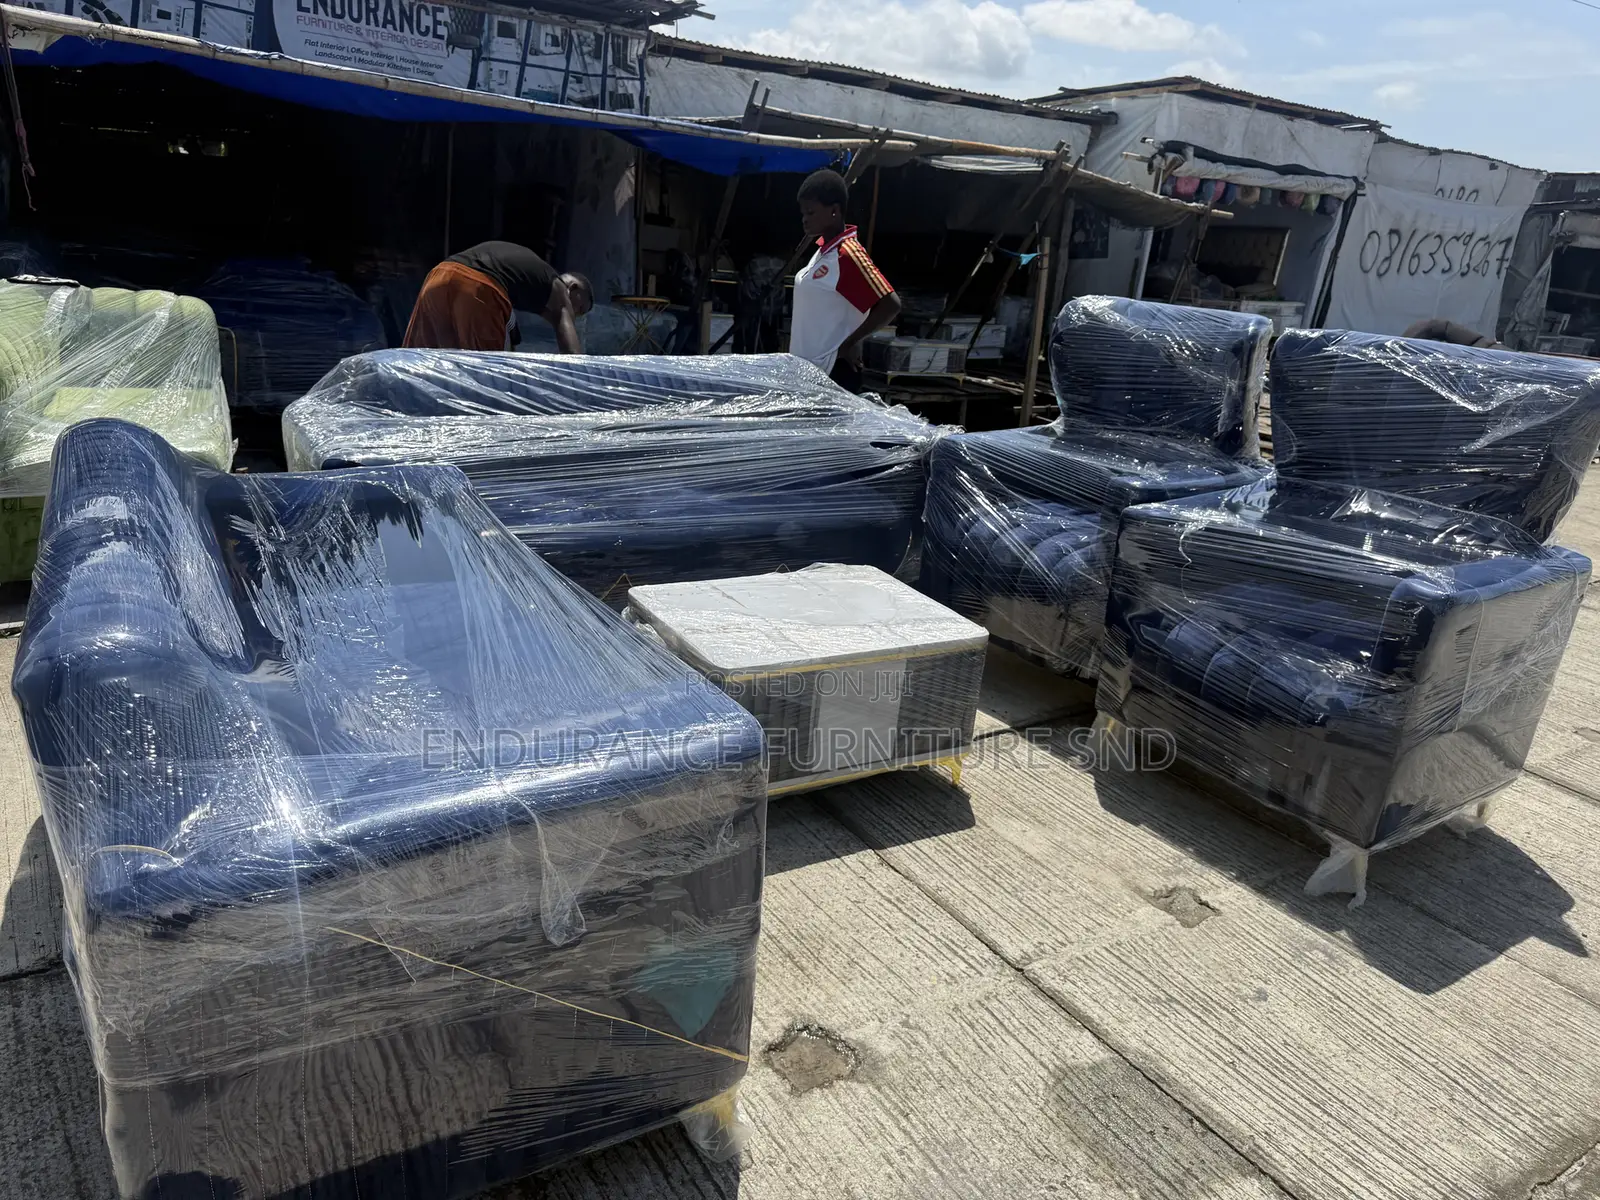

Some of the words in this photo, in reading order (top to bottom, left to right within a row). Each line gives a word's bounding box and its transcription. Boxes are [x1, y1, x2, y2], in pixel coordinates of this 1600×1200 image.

[297, 15, 353, 34] FURNITURE
[366, 28, 409, 45] INTERIOR
[410, 37, 444, 51] DESIGN
[304, 38, 319, 47] Flat
[320, 41, 346, 52] Interior
[350, 46, 370, 56] Office
[370, 50, 395, 61] Interior
[399, 55, 420, 66] House
[420, 60, 444, 70] Interior
[314, 49, 353, 61] Landscape
[357, 56, 386, 67] Modular
[386, 61, 412, 72] Kitchen
[416, 67, 436, 77] Decor
